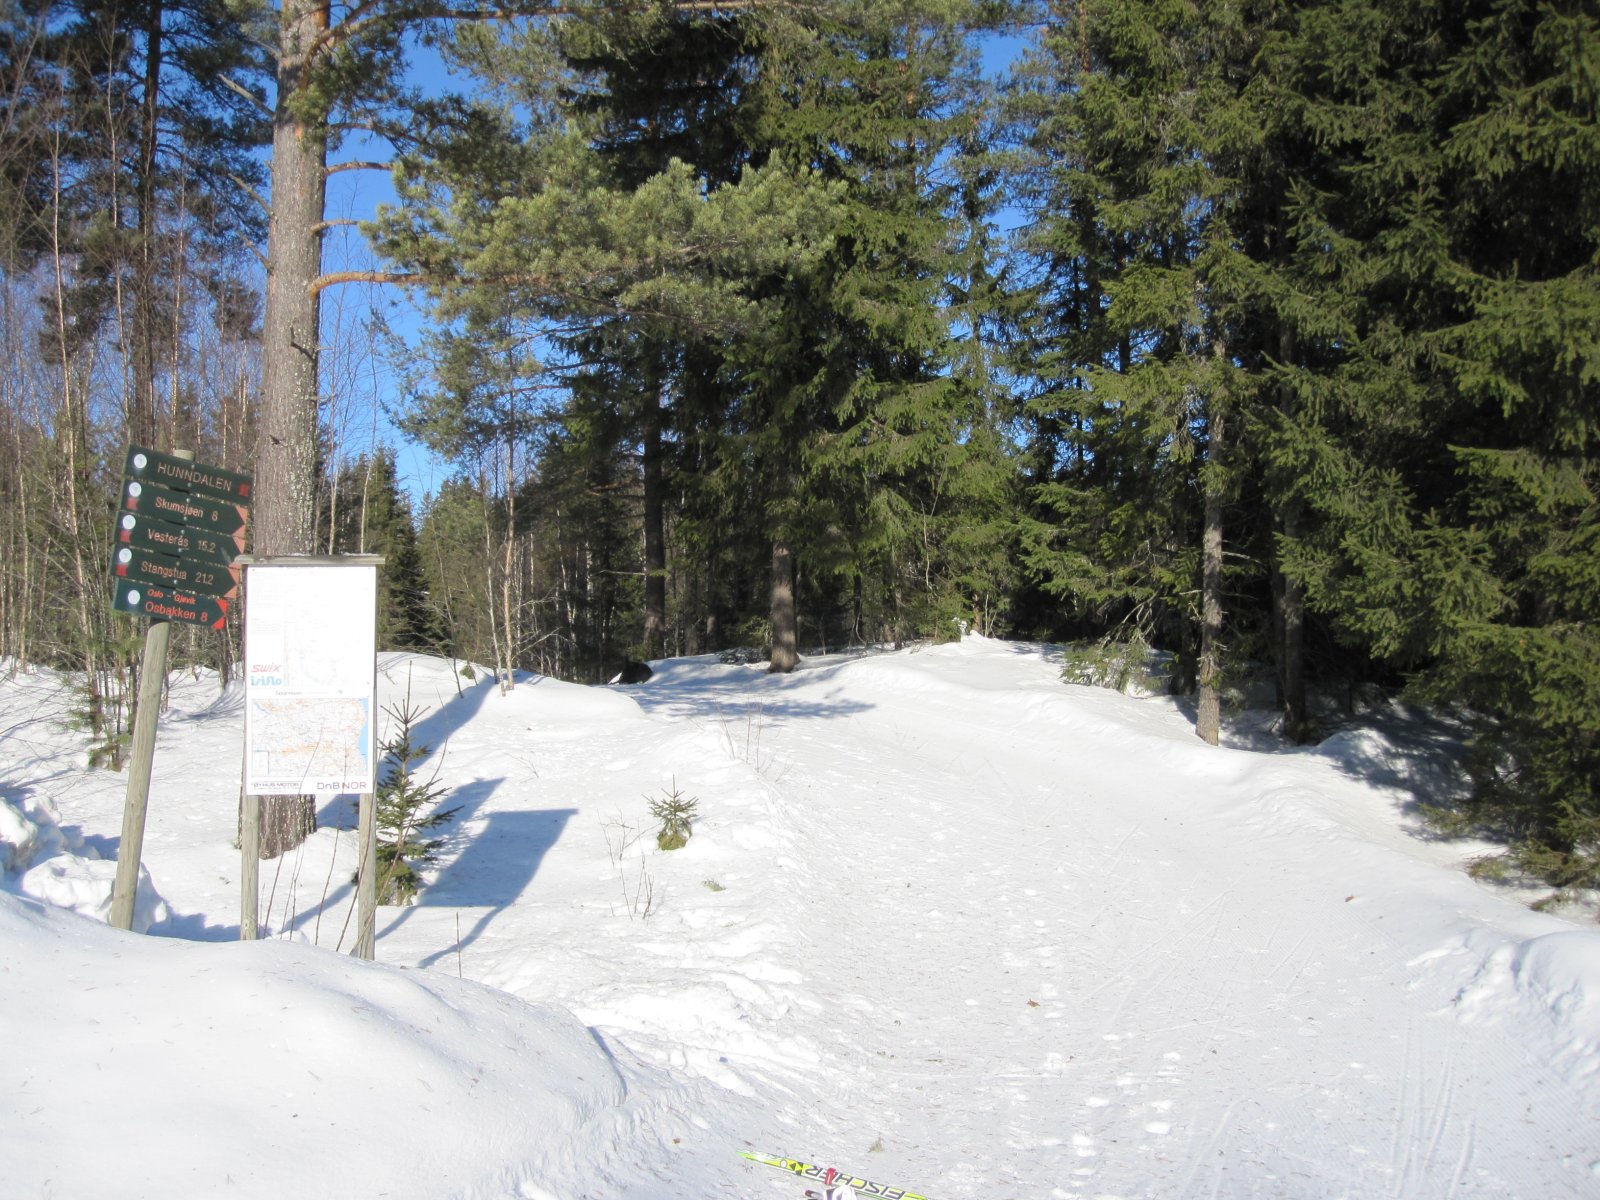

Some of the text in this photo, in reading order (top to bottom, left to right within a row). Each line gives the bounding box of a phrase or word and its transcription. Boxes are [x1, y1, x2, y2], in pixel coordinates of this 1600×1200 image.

[157, 462, 232, 491] HUNNDALEN
[155, 496, 218, 521] Skumsjøen 8
[148, 528, 216, 553] Vesterås 15.2
[140, 560, 187, 580] Stangstua
[147, 588, 164, 598] Oslo
[174, 593, 196, 605] Gjøvik
[145, 601, 208, 622] Osbakken 8
[316, 781, 367, 790] DnB NOR
